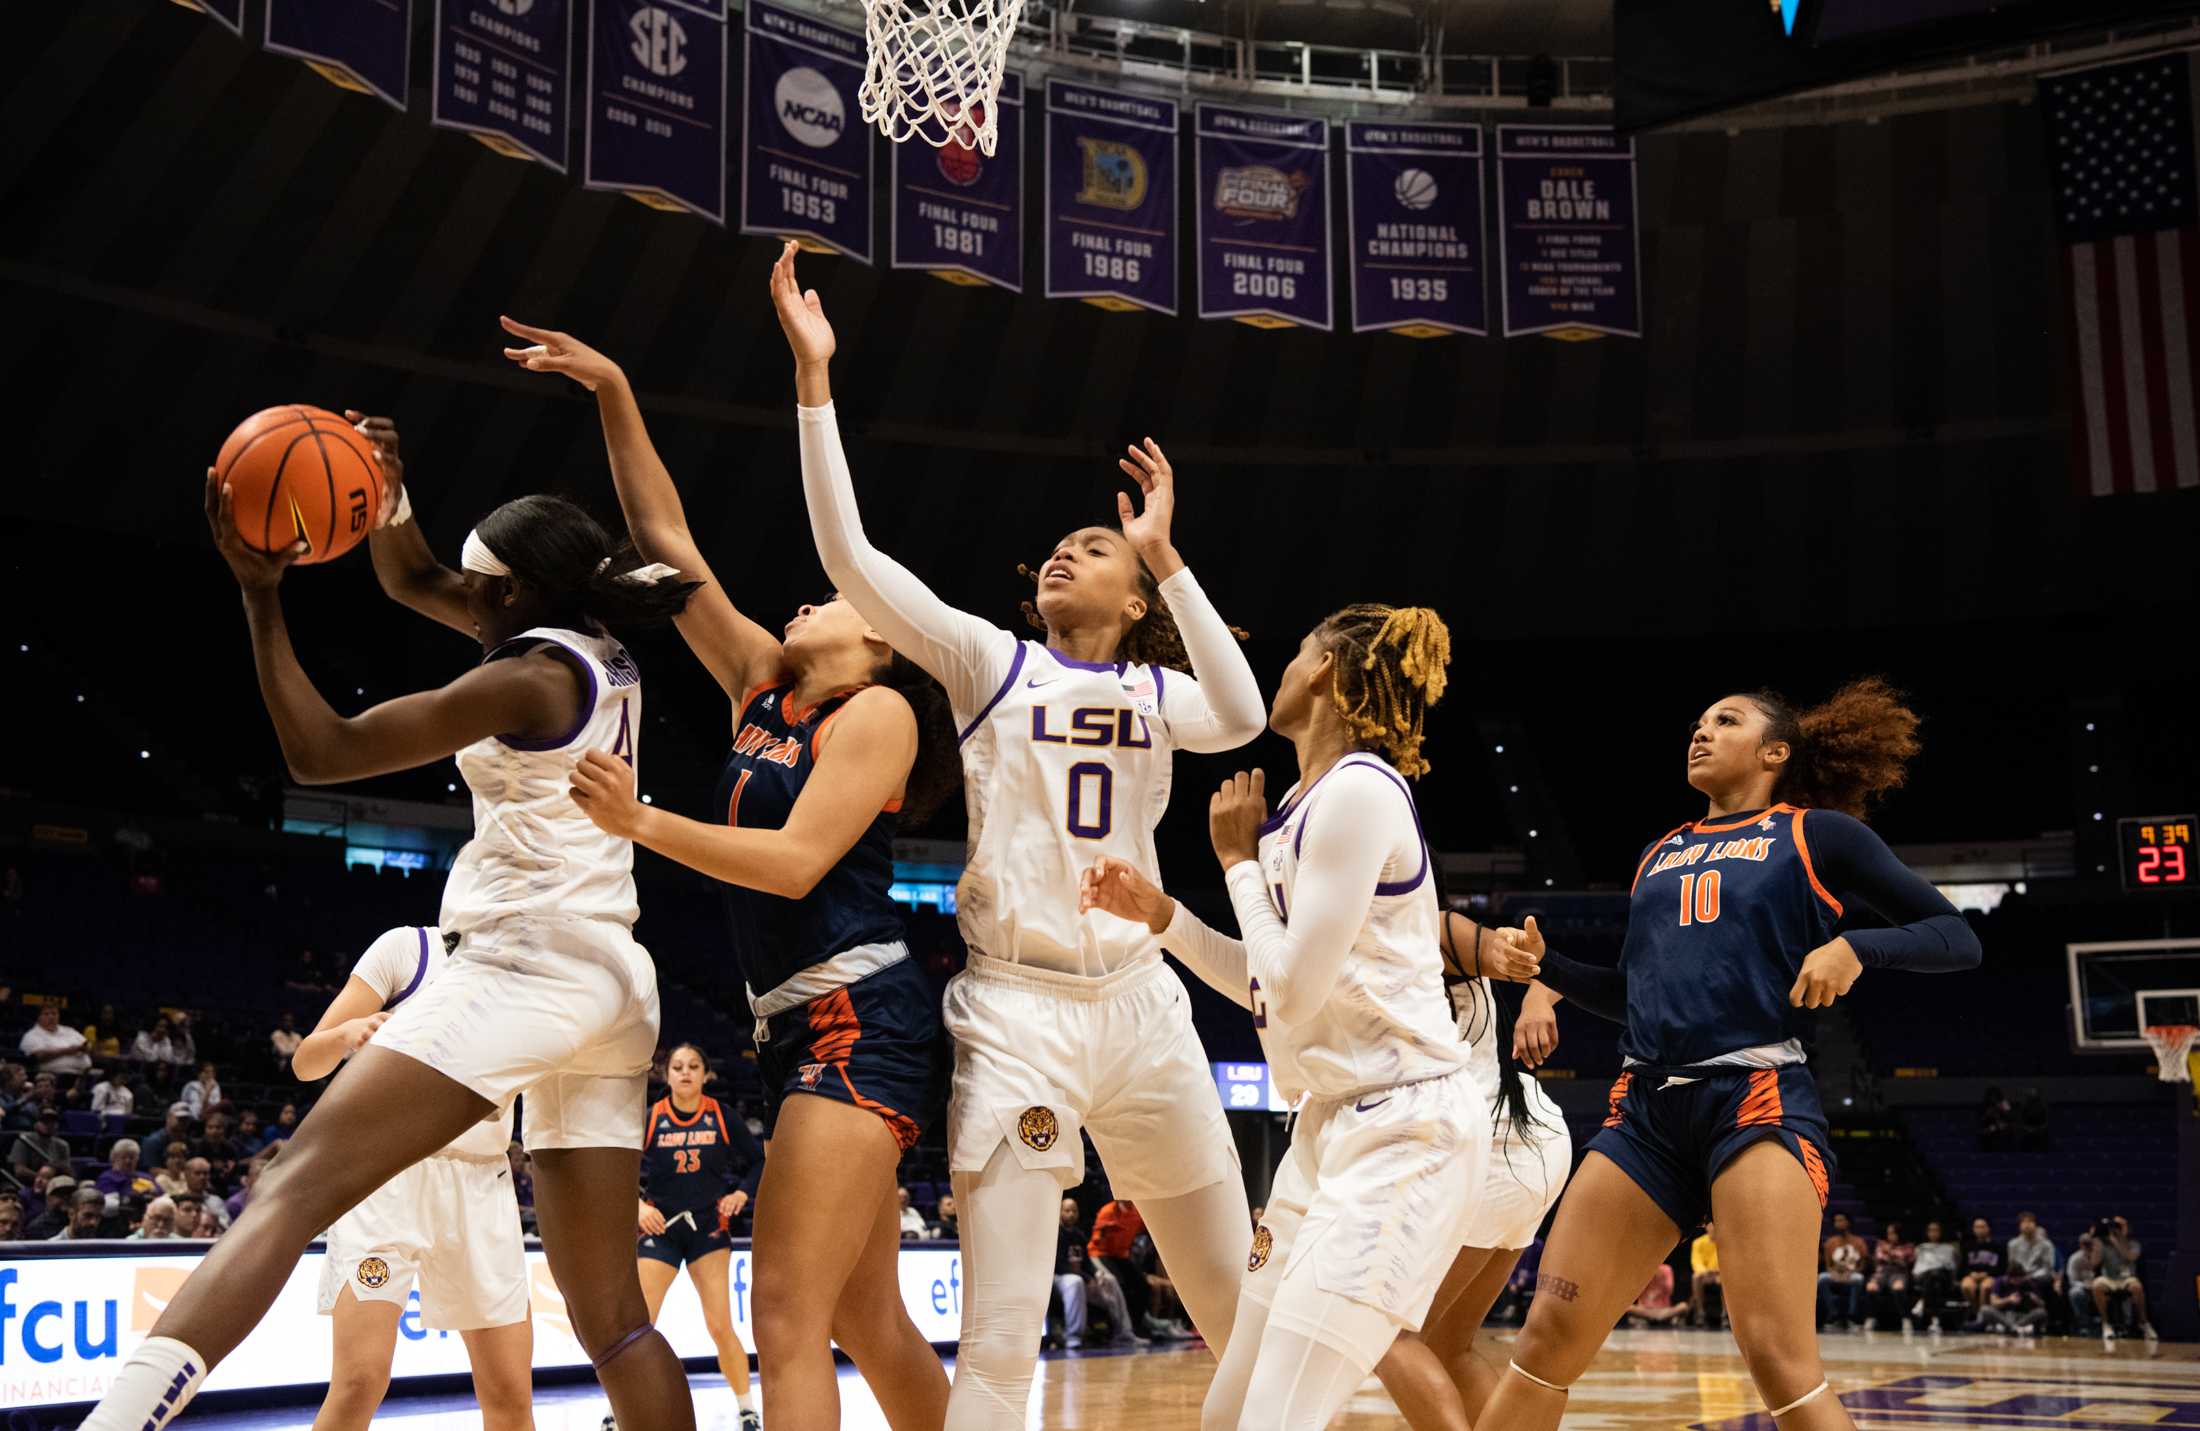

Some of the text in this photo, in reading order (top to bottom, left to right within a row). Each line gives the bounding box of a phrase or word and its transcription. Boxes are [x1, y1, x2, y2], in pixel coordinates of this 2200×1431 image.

[470, 10, 541, 52] CHAMPIONS
[629, 6, 688, 76] SEC
[622, 75, 694, 110] CHAMPIONS
[784, 99, 842, 132] NCAA
[769, 163, 848, 200] FINAL FOUR
[1222, 187, 1288, 208] FOUR
[1540, 178, 1596, 200] DALE
[781, 186, 836, 224] 1953
[918, 202, 998, 233] FINAL FOUR
[1527, 198, 1610, 221] BROWN
[934, 223, 983, 256] 1981
[1071, 231, 1152, 258] FINAL FOUR
[1376, 222, 1457, 242] NATIONAL
[1223, 252, 1304, 275] FINAL FOUR
[1368, 239, 1469, 259] CHAMPIONS
[1084, 251, 1140, 283] 1986
[1232, 271, 1296, 300] 2006
[1390, 277, 1448, 302] 1935
[1030, 704, 1153, 750] LSU
[728, 768, 752, 827] 1
[1066, 760, 1113, 841] 0
[1647, 836, 1776, 878] LADY LIONS
[2138, 846, 2186, 882] 23
[1680, 869, 1721, 926] 10
[673, 1148, 702, 1174] 23
